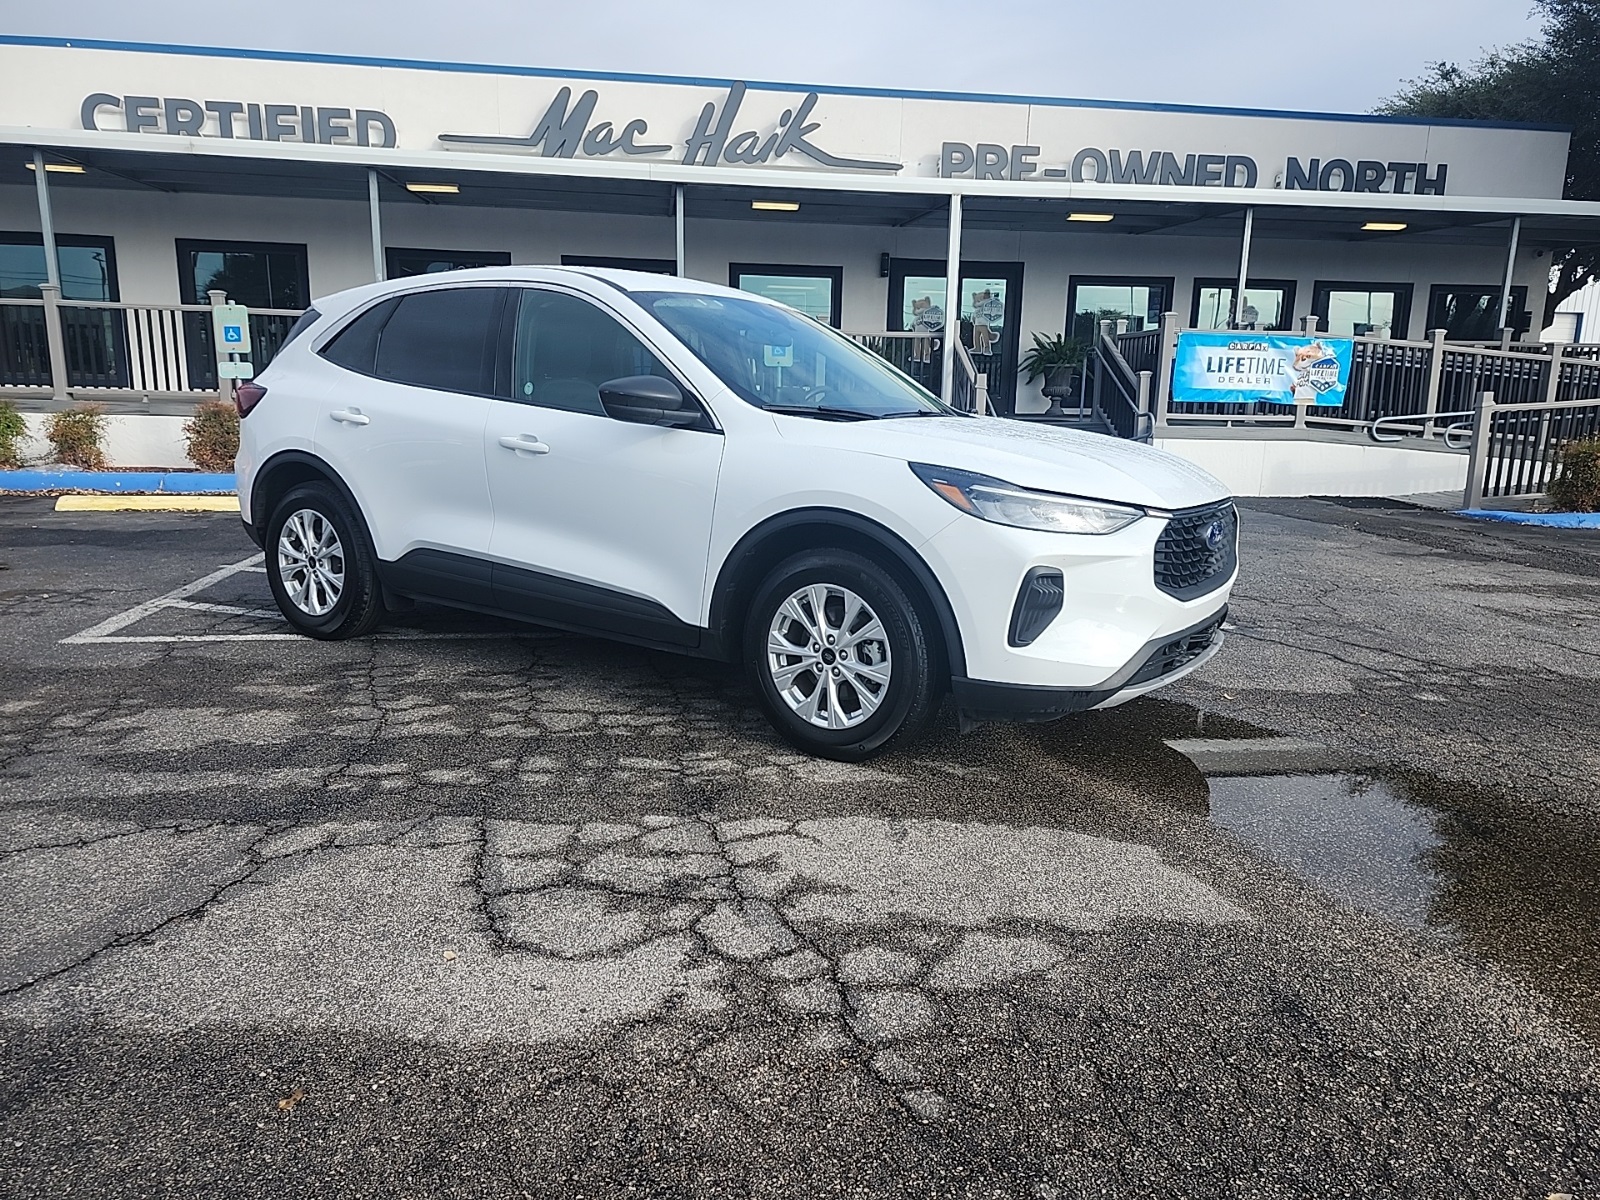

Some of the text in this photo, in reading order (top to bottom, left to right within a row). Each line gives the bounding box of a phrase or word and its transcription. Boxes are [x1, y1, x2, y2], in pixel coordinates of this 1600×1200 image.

[81, 92, 397, 149] CERTIFIED
[438, 80, 904, 171] Mac Haik
[940, 141, 1448, 196] PRE-OWNED NORTH
[1228, 342, 1269, 352] CARFAX
[1206, 356, 1287, 376] LIFETIME
[1218, 376, 1271, 384] DEALER
